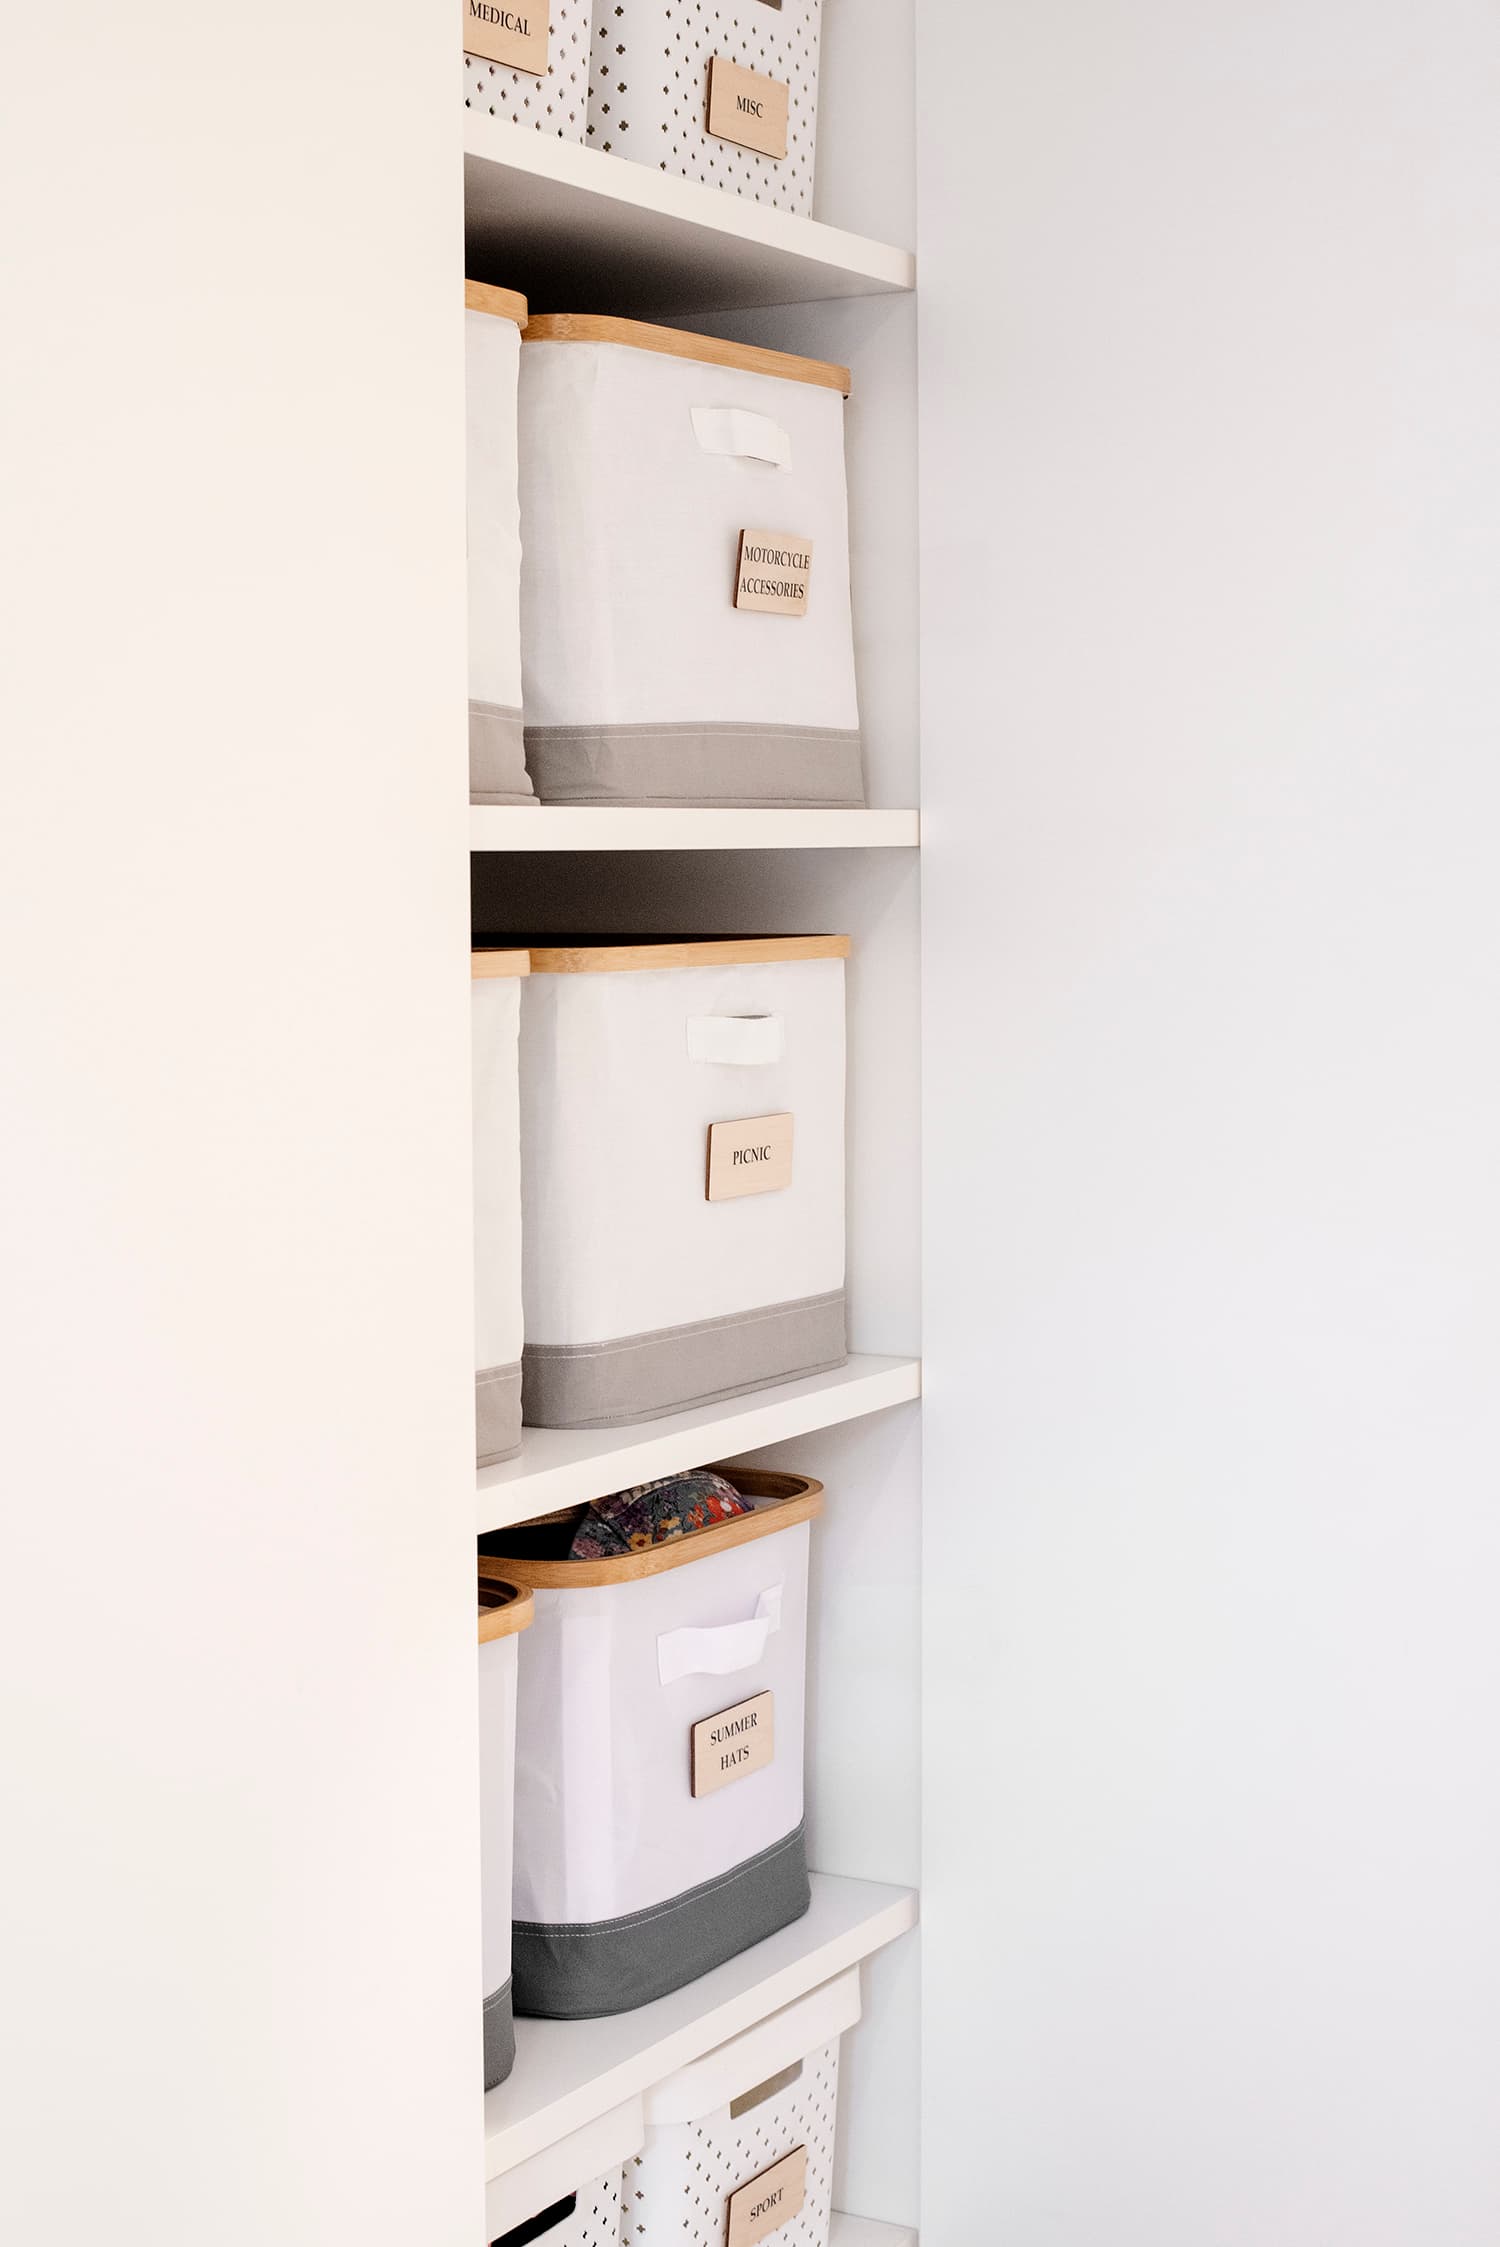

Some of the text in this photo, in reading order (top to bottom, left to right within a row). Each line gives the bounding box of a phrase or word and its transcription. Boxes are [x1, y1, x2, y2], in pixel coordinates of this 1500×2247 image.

[470, 0, 531, 36] MEDICAL
[737, 95, 763, 118] MISC
[744, 546, 810, 570] MOTORCYCLE
[740, 577, 805, 599] ACCESSORIES
[733, 1145, 771, 1165] PICNIC
[710, 1712, 758, 1746] SUMMER
[720, 1745, 750, 1770] HATS
[750, 2187, 784, 2222] SPORT
